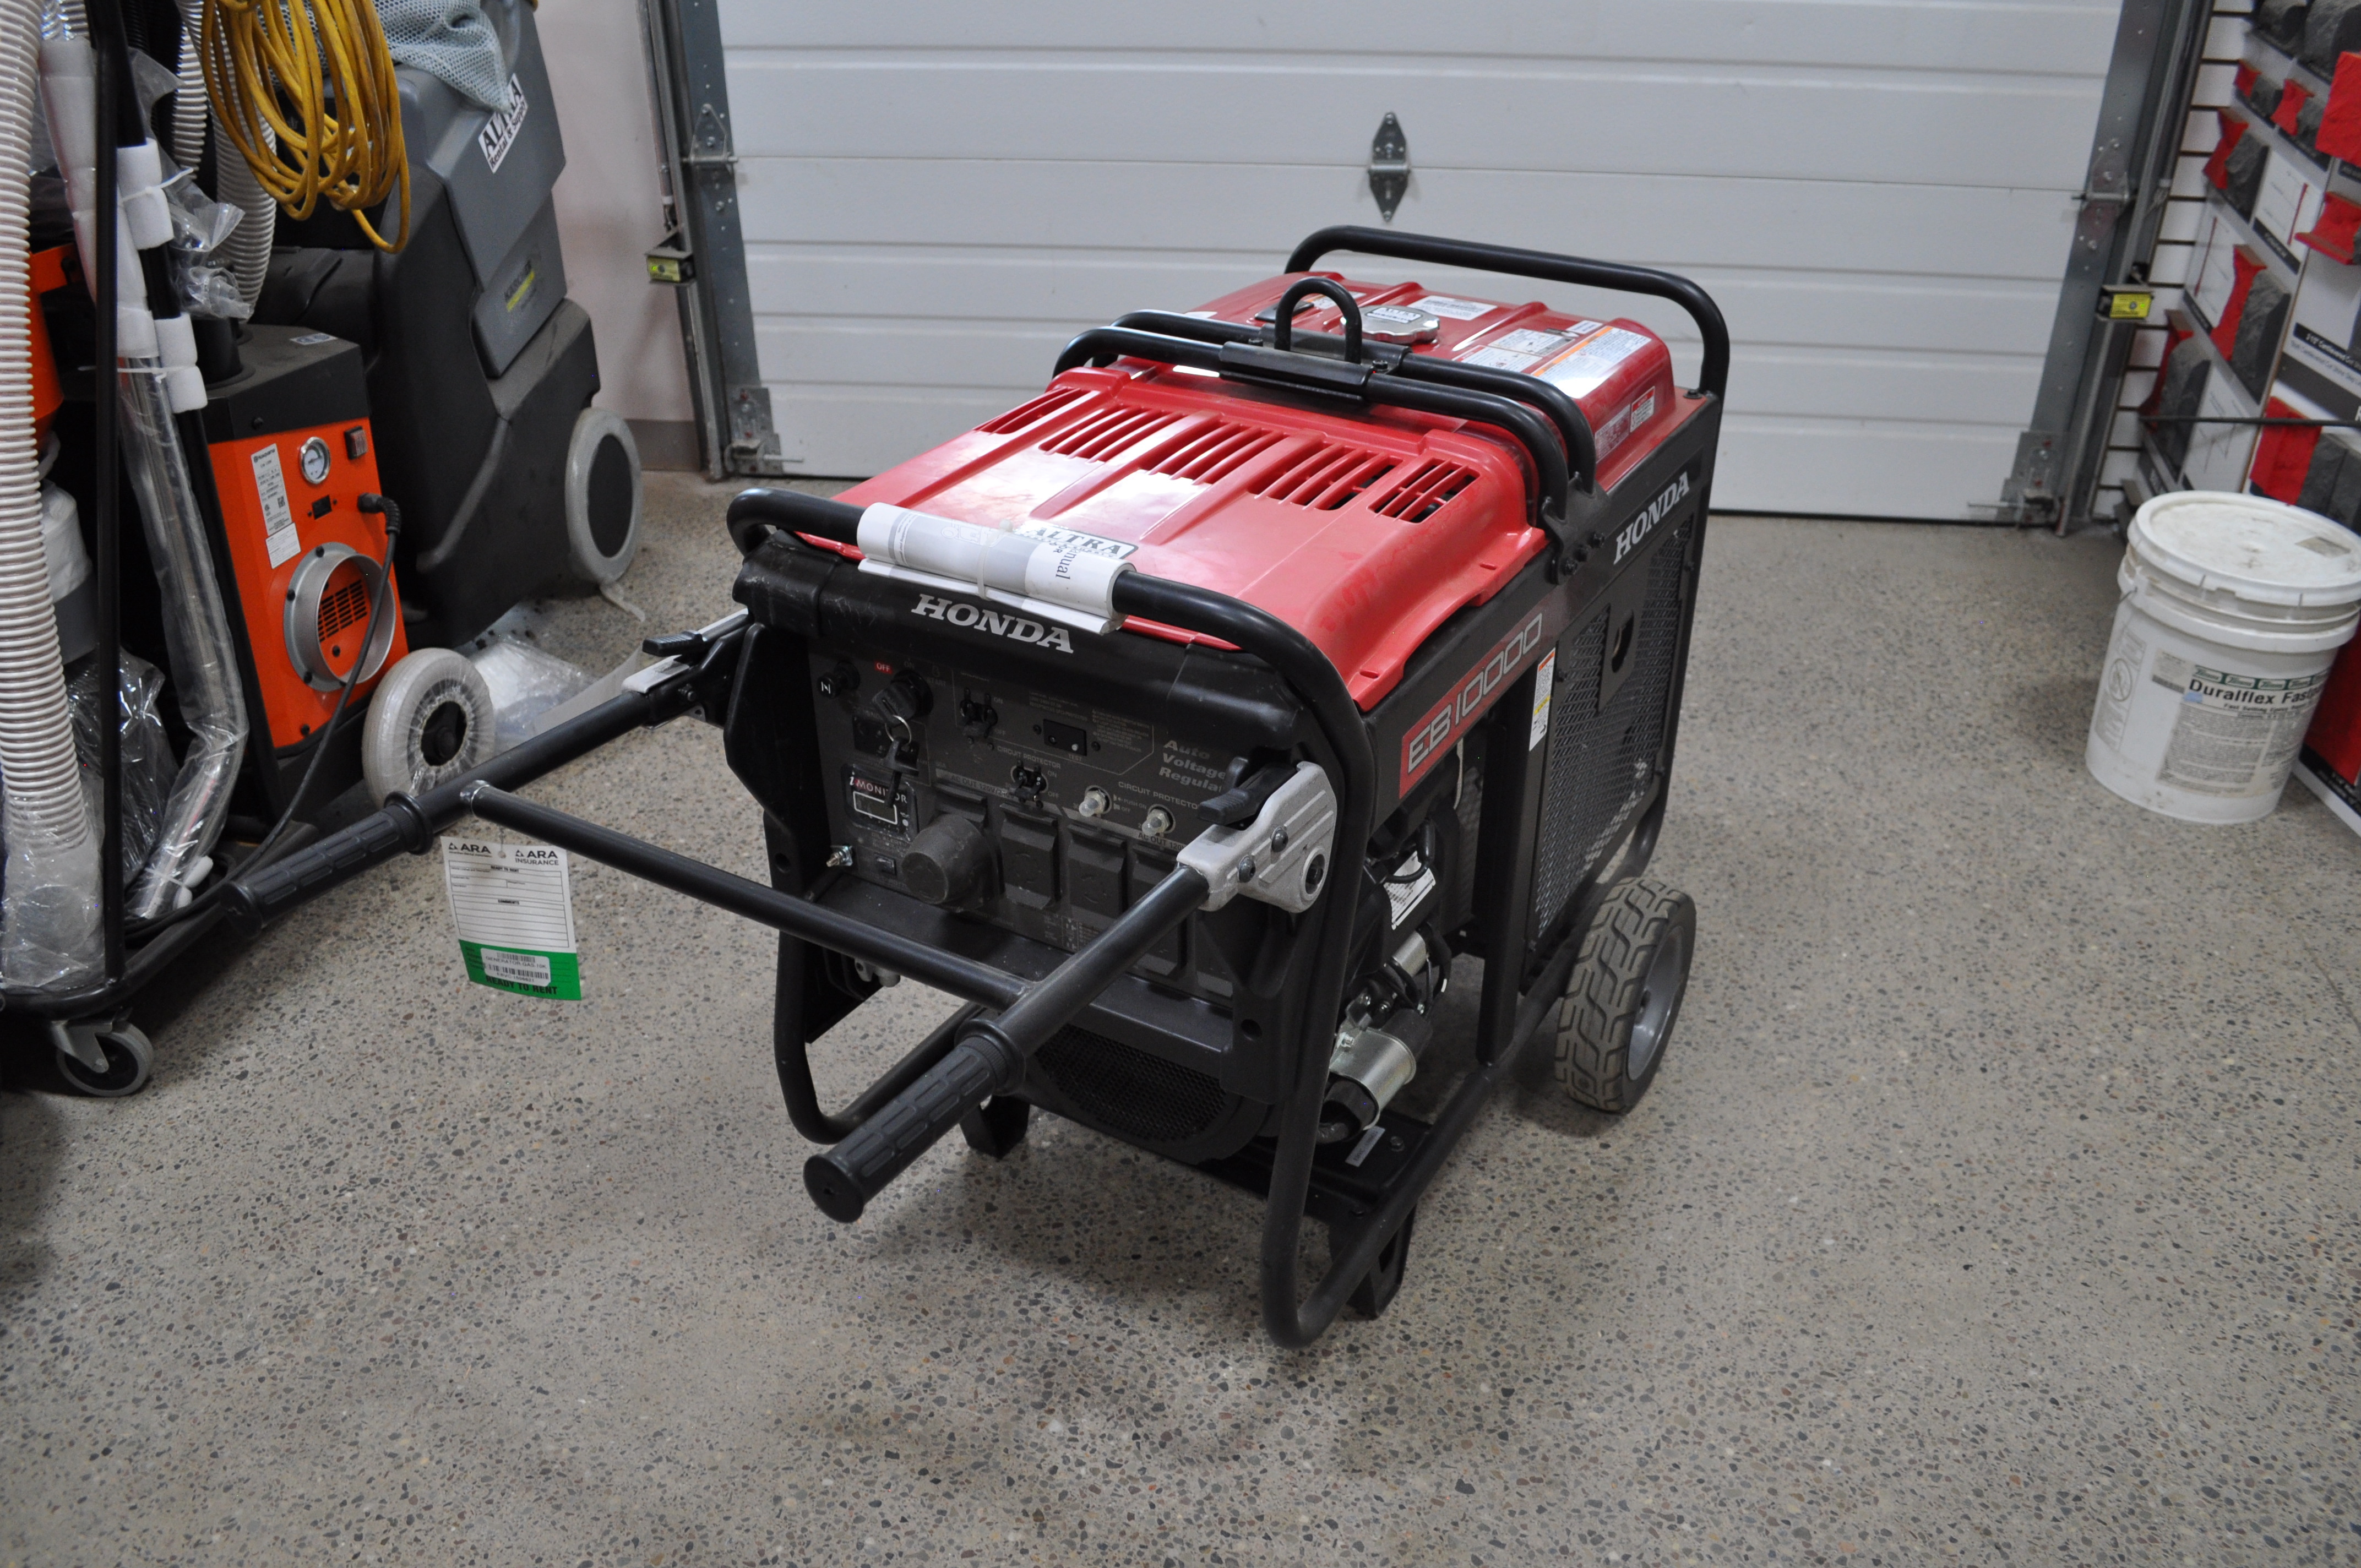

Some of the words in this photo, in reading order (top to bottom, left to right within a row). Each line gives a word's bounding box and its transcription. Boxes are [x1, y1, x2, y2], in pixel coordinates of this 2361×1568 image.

[489, 136, 508, 168] Rental
[507, 127, 513, 139] &
[1613, 472, 1690, 565] HONDA
[1027, 527, 1122, 555] ALTRA
[911, 594, 1074, 654] HONDA
[876, 662, 891, 672] OFF
[1407, 612, 1543, 773] EB10000
[2189, 678, 2276, 705] Duralflex
[997, 747, 1021, 758] CIRCUIT
[1023, 753, 1062, 770] PROTECTOR
[1068, 754, 1082, 762] TEST
[1163, 739, 1210, 760] Auto
[1163, 752, 1226, 780] Voltage
[1118, 781, 1151, 796] CIRCUIT
[1153, 792, 1199, 810] PROTECTO
[460, 843, 491, 854] ARA
[1138, 832, 1149, 841] AC
[1151, 836, 1167, 847] OUT
[515, 858, 559, 866] INSURANCE
[527, 850, 558, 859] ARA
[486, 975, 515, 989] READY
[518, 982, 529, 991] TO
[532, 985, 558, 995] RENT
